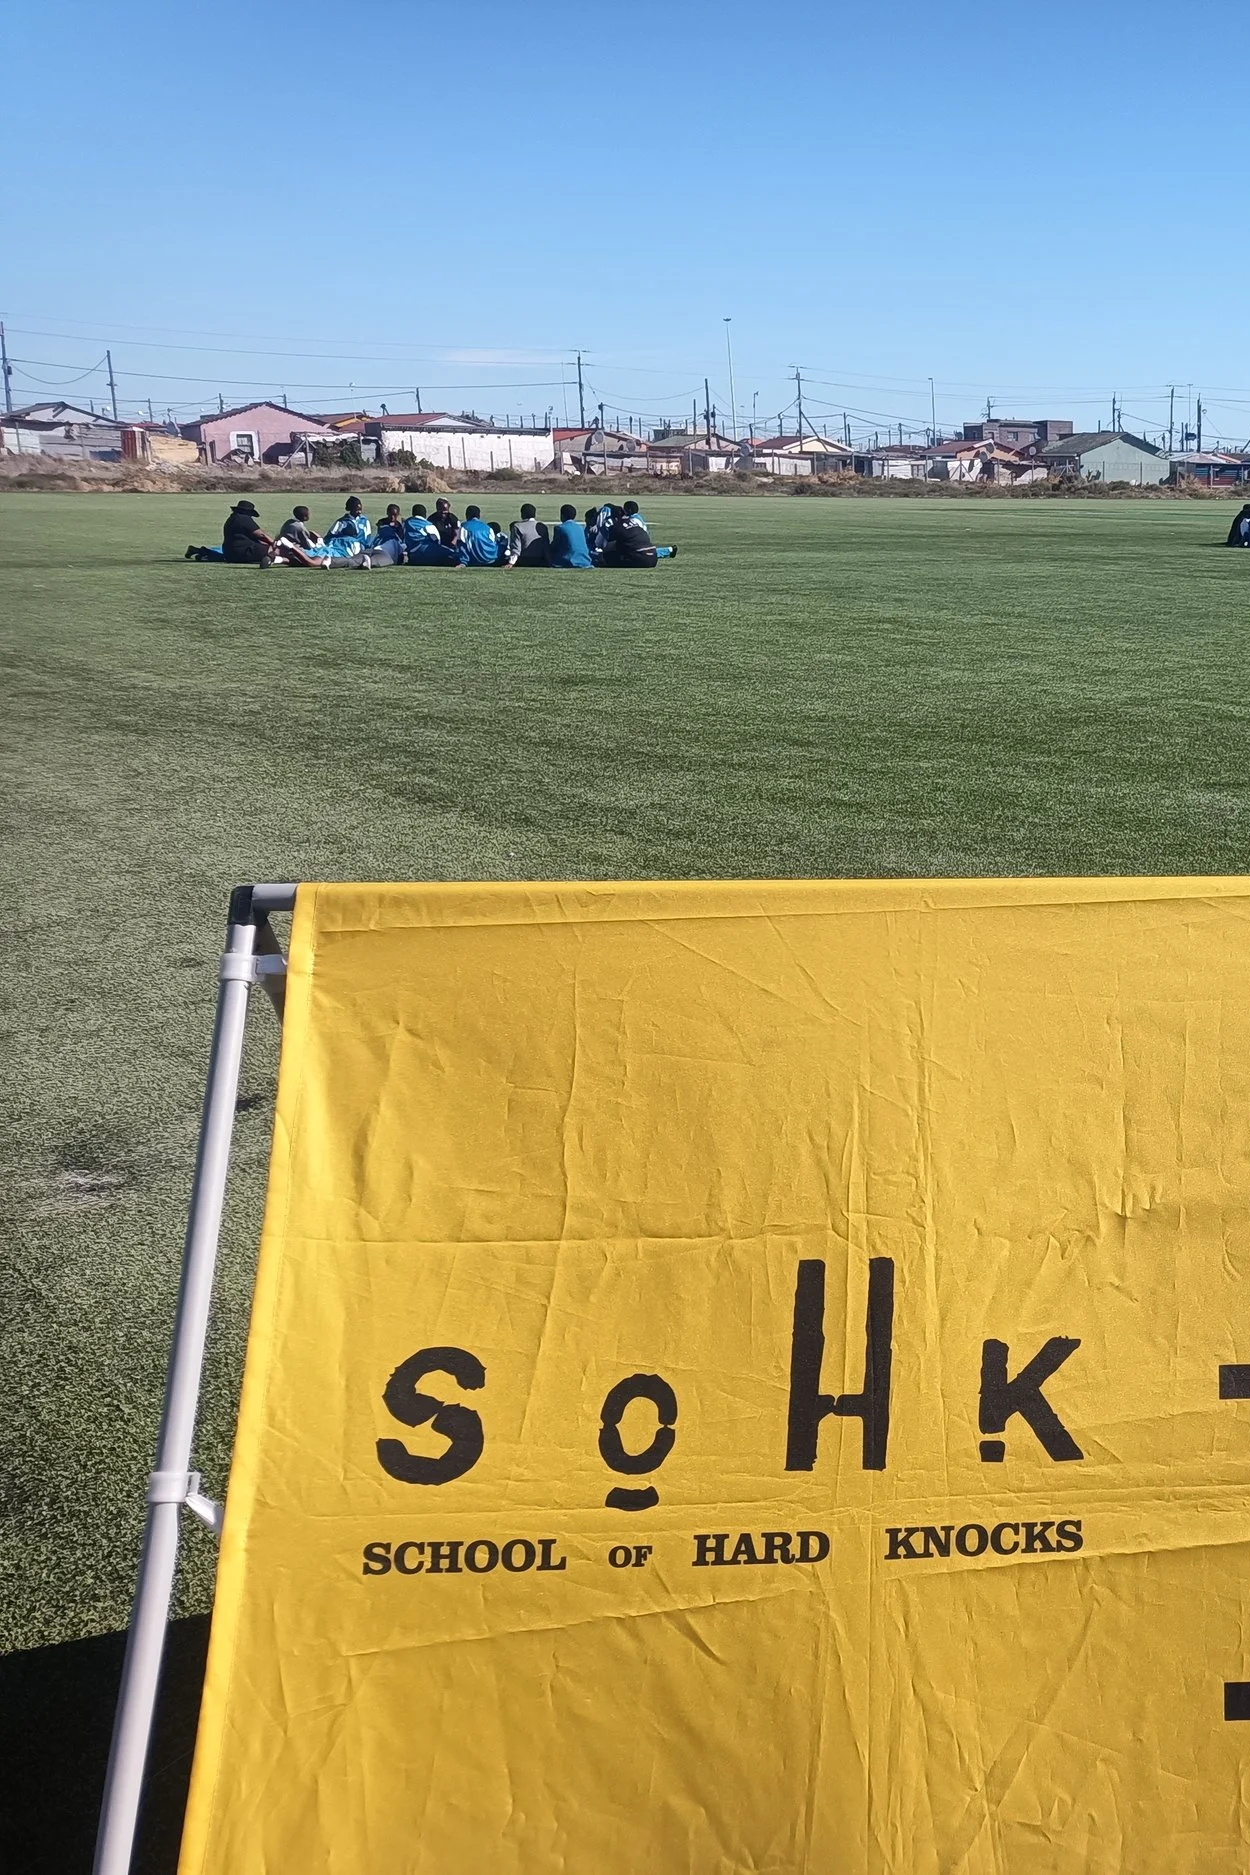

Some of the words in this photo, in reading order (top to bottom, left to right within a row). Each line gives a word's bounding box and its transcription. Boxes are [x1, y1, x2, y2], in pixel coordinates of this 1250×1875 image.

[362, 1538, 567, 1576] SCHOOL
[608, 1545, 653, 1569] OF
[691, 1530, 830, 1567] HARD
[884, 1519, 1084, 1560] KNOCKS
